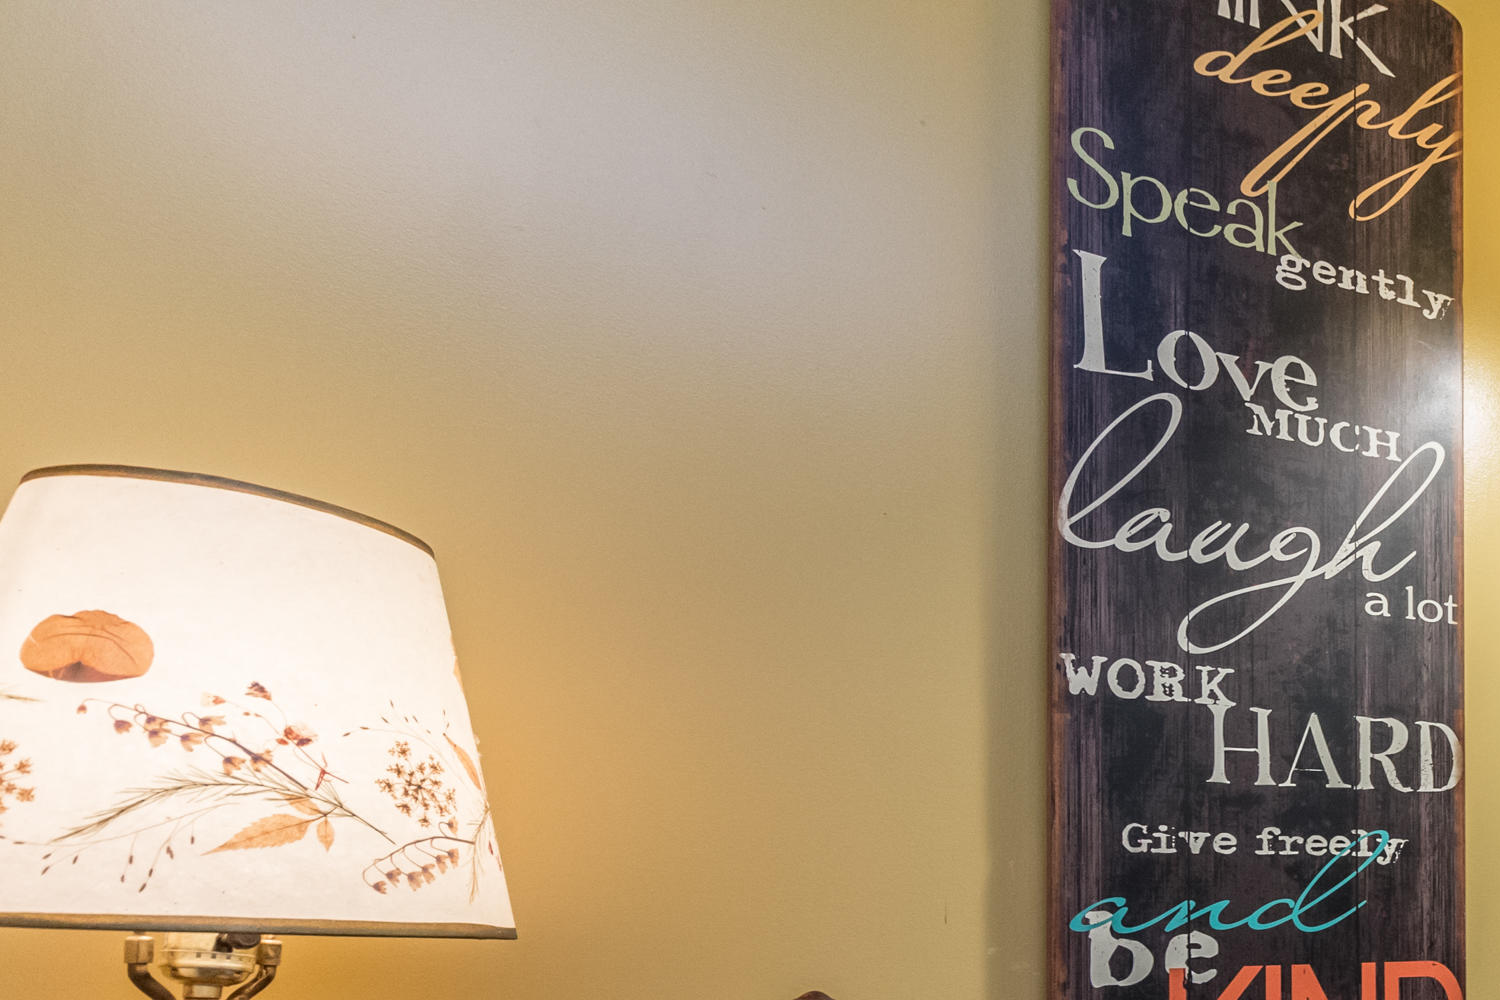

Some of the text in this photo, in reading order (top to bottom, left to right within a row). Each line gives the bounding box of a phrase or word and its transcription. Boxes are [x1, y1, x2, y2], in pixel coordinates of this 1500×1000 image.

[1193, 9, 1463, 221] deeply
[1067, 126, 1304, 259] Speak
[1275, 253, 1455, 320] gently
[1073, 249, 1319, 411] Love
[1245, 402, 1402, 462] MUCH
[1058, 392, 1446, 655] laugh
[1364, 585, 1458, 625] a lot
[1059, 653, 1237, 707] WORK
[1205, 704, 1463, 793] HARD
[1068, 829, 1390, 934] and
[1121, 822, 1409, 866] Give freely
[1085, 910, 1220, 989] be
